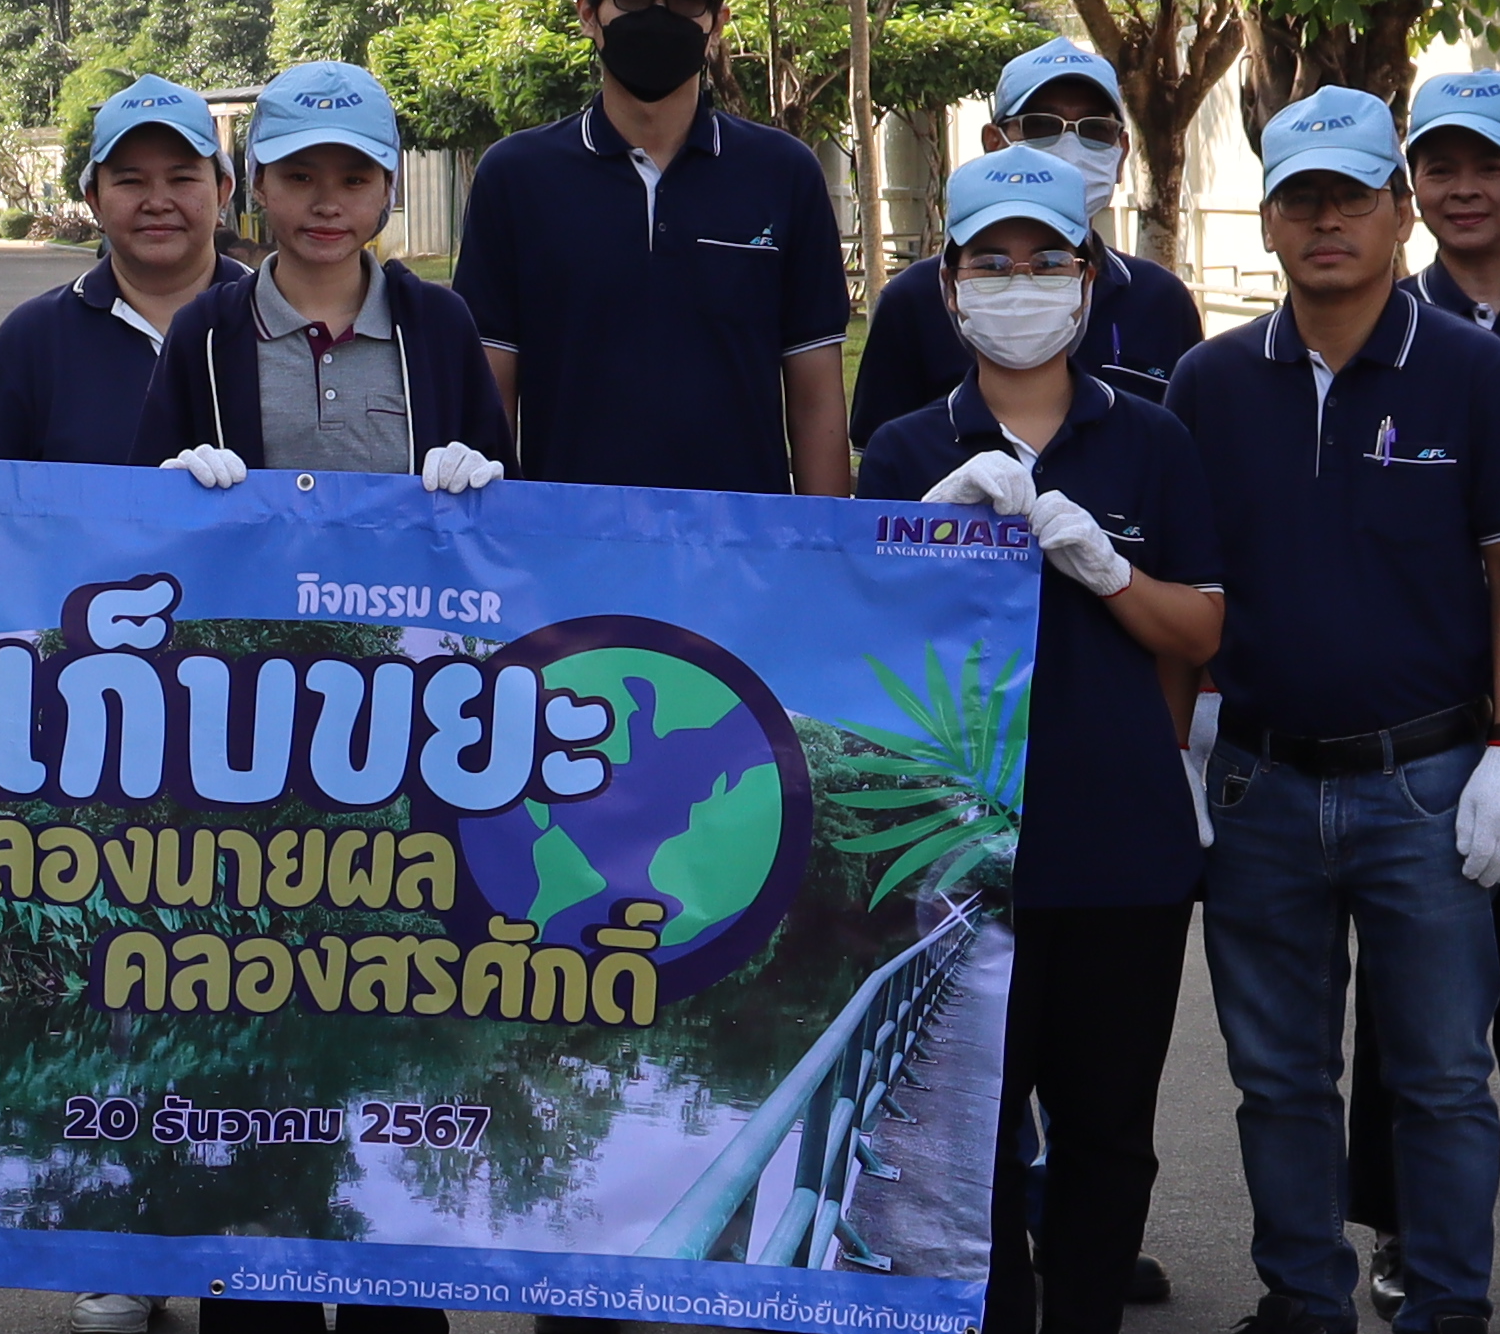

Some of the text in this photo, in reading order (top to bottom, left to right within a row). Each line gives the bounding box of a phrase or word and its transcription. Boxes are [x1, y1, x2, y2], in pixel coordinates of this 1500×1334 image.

[876, 515, 1030, 548] INOAC
[876, 545, 938, 558] BANGKOK
[940, 548, 978, 559] FOAM
[296, 573, 501, 623] กิจกรรม CSR
[104, 902, 664, 1027] คลองสรศักดิ์
[63, 1095, 491, 1148] 20 ธันวาคม 2567
[230, 1266, 510, 1302] ร่วมกันรักษาความสะอาด
